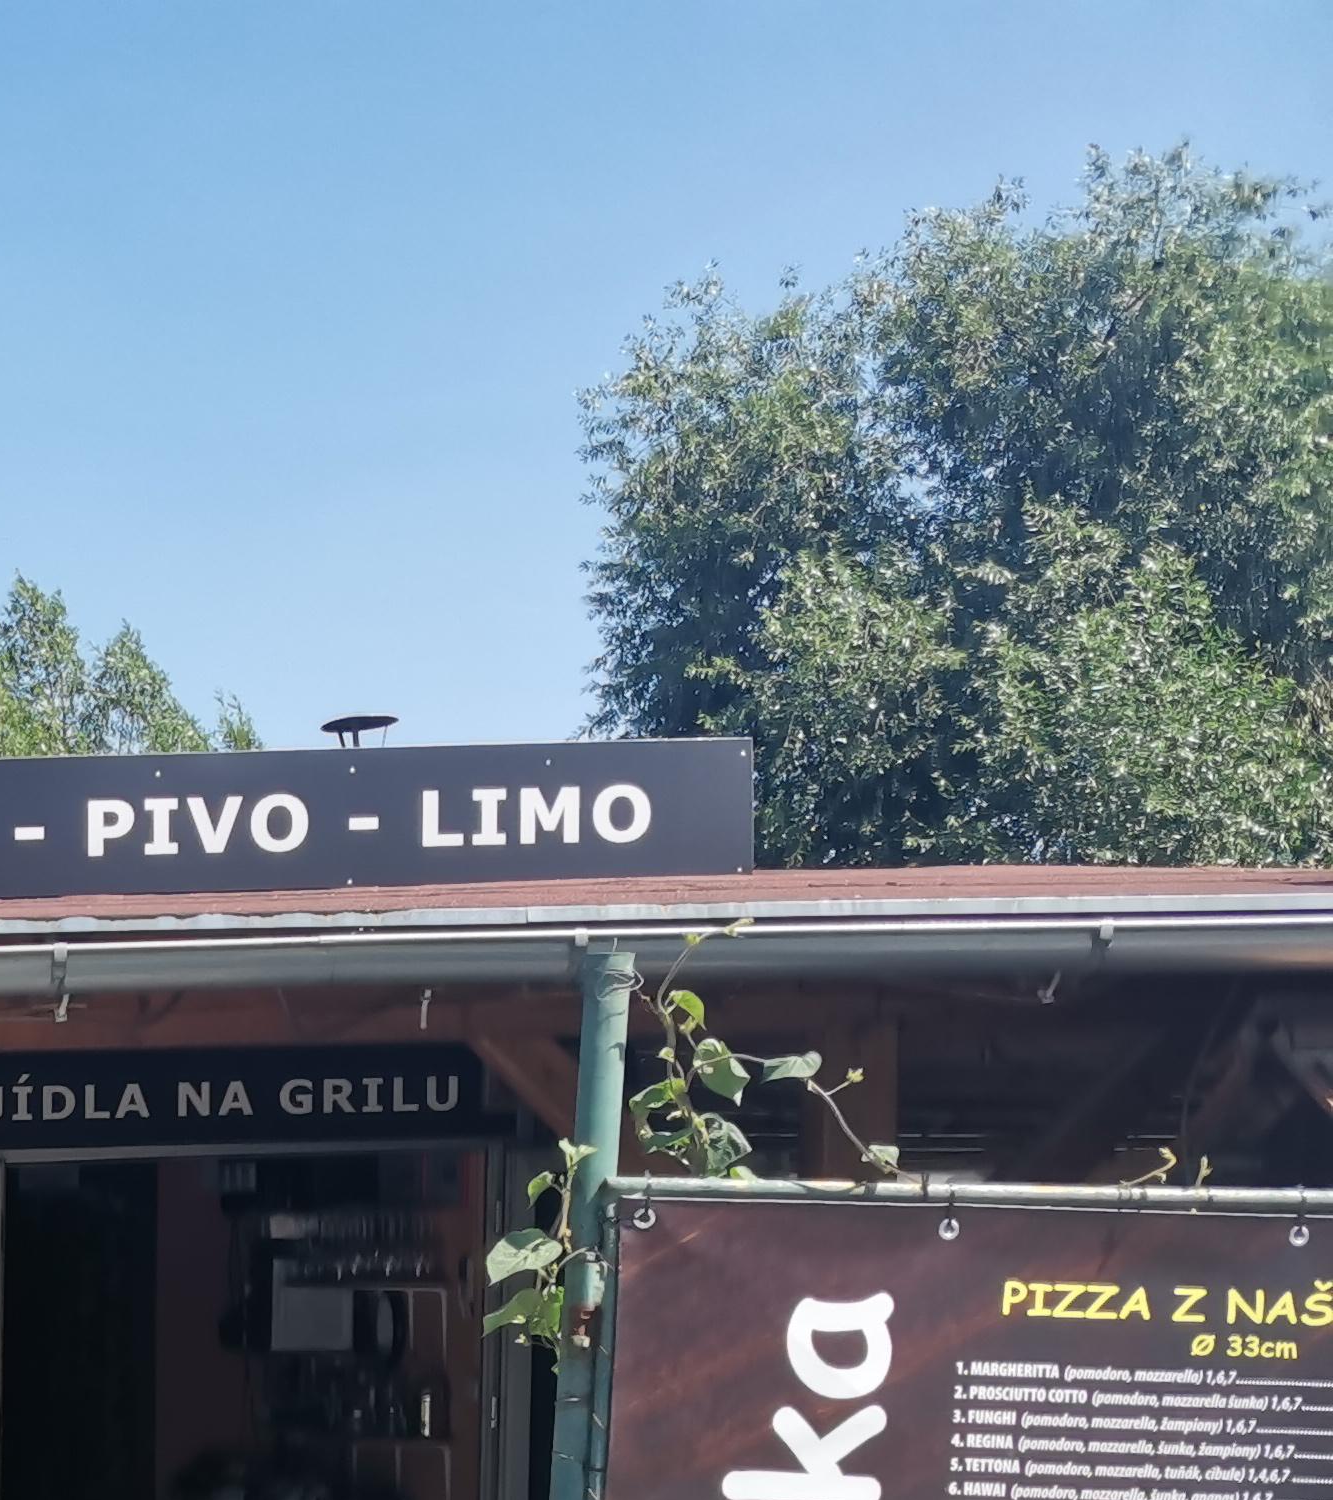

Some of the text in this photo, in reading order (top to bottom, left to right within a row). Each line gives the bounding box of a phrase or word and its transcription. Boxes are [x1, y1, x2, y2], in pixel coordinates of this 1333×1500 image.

[86, 792, 310, 858] PIVO
[419, 783, 653, 848] LIMO
[177, 1080, 253, 1117] NA
[279, 1075, 458, 1116] GRILU
[1001, 1278, 1333, 1327] PIZZA Z NAŠ
[1226, 1333, 1298, 1360] 33cm
[956, 1361, 968, 1377] 1.
[970, 1361, 1060, 1379] MARGHERITTA
[1064, 1364, 1132, 1384] (pomodoro,
[1134, 1367, 1204, 1386] mozzarella)
[954, 1386, 967, 1401] 2.
[969, 1386, 1047, 1403] PROSCIUTTO
[1048, 1389, 1088, 1405] COTTO
[1092, 1390, 1160, 1409] (pomodoro,
[1162, 1393, 1227, 1410] mozzarella
[1227, 1394, 1269, 1411] šunka)
[952, 1410, 965, 1424] 3.
[967, 1410, 1017, 1426] FUNGHI
[1021, 1411, 1089, 1431] (pomodoro,
[1091, 1414, 1159, 1433] mozzarella,
[1160, 1416, 1223, 1435] žampiony)
[951, 1434, 964, 1448] 4.
[966, 1434, 1013, 1450] REGINA
[1017, 1435, 1086, 1455] (pomodoro,
[1088, 1438, 1155, 1457] mozzarella,
[1157, 1440, 1197, 1457] šunka,
[1198, 1441, 1262, 1460] žampiony)
[949, 1458, 963, 1473] 5.
[965, 1458, 1020, 1475] TETTONA
[1024, 1460, 1093, 1479] (pomodoro,
[1094, 1463, 1162, 1481] mozzarella,
[1204, 1466, 1245, 1483] cibule)
